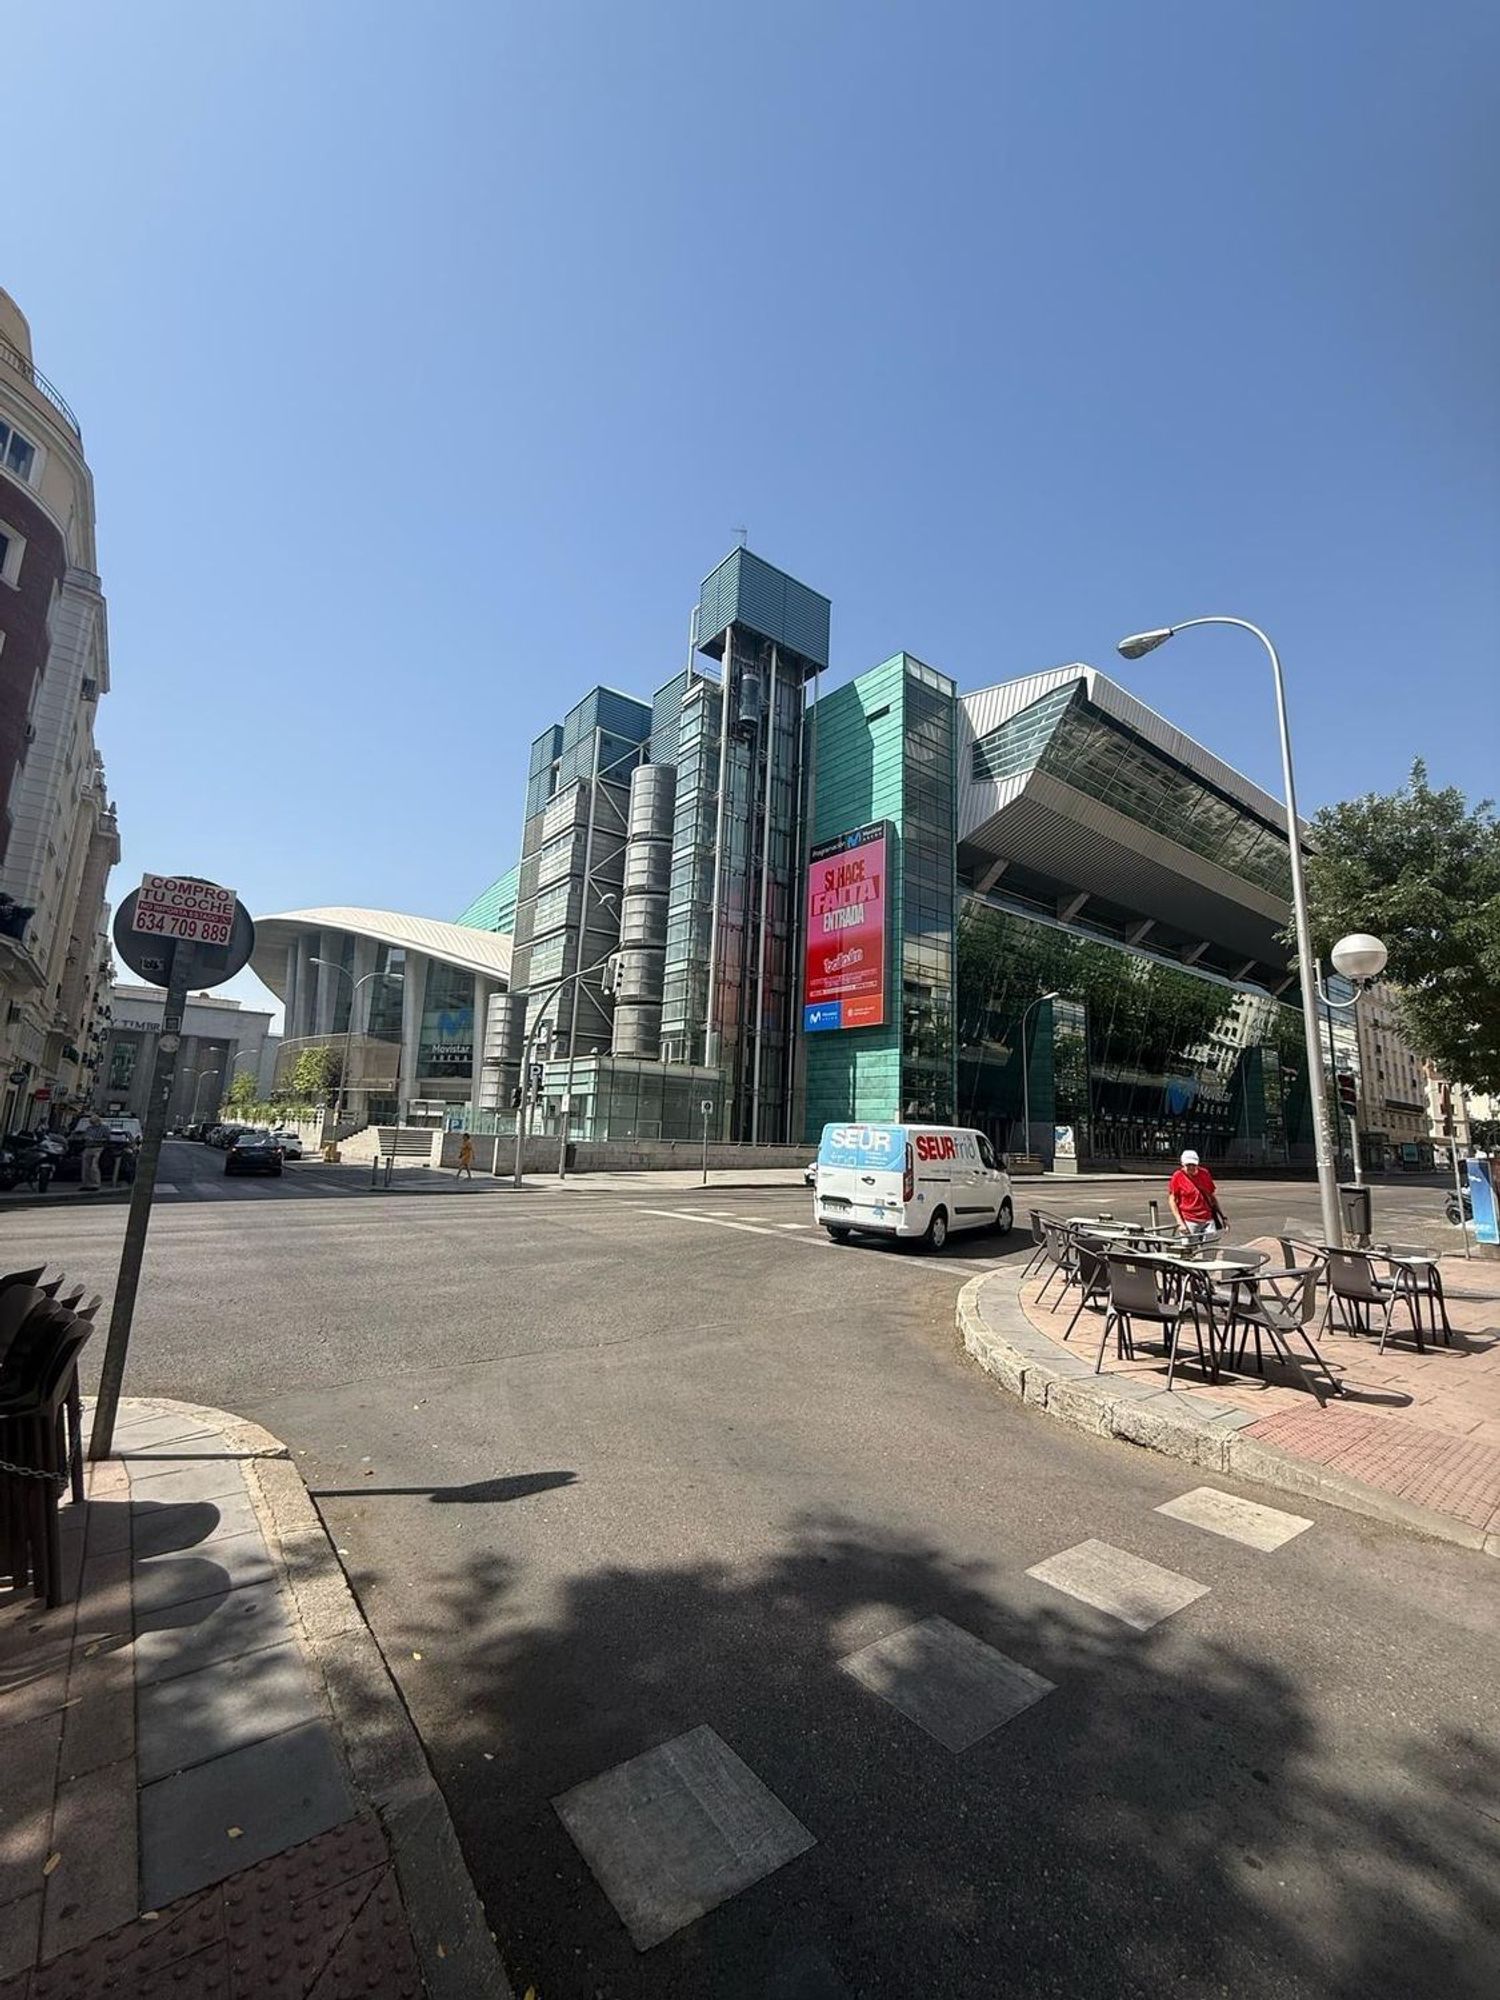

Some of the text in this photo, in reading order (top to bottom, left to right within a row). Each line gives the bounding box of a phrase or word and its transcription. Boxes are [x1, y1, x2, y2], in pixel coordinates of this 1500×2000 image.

[837, 859, 865, 888] HACE
[142, 888, 234, 915] TU COCHE
[151, 877, 229, 902] COMPRO
[812, 876, 879, 917] FALTA
[140, 902, 219, 923] NO IMPORTA ESTADO
[823, 902, 865, 932] ENTRADA
[136, 911, 228, 943] 634 709 889
[121, 1019, 161, 1032] TIMBR
[432, 1043, 471, 1054] Movistar
[1195, 1103, 1228, 1115] ARENA
[830, 1126, 892, 1152] SEUR
